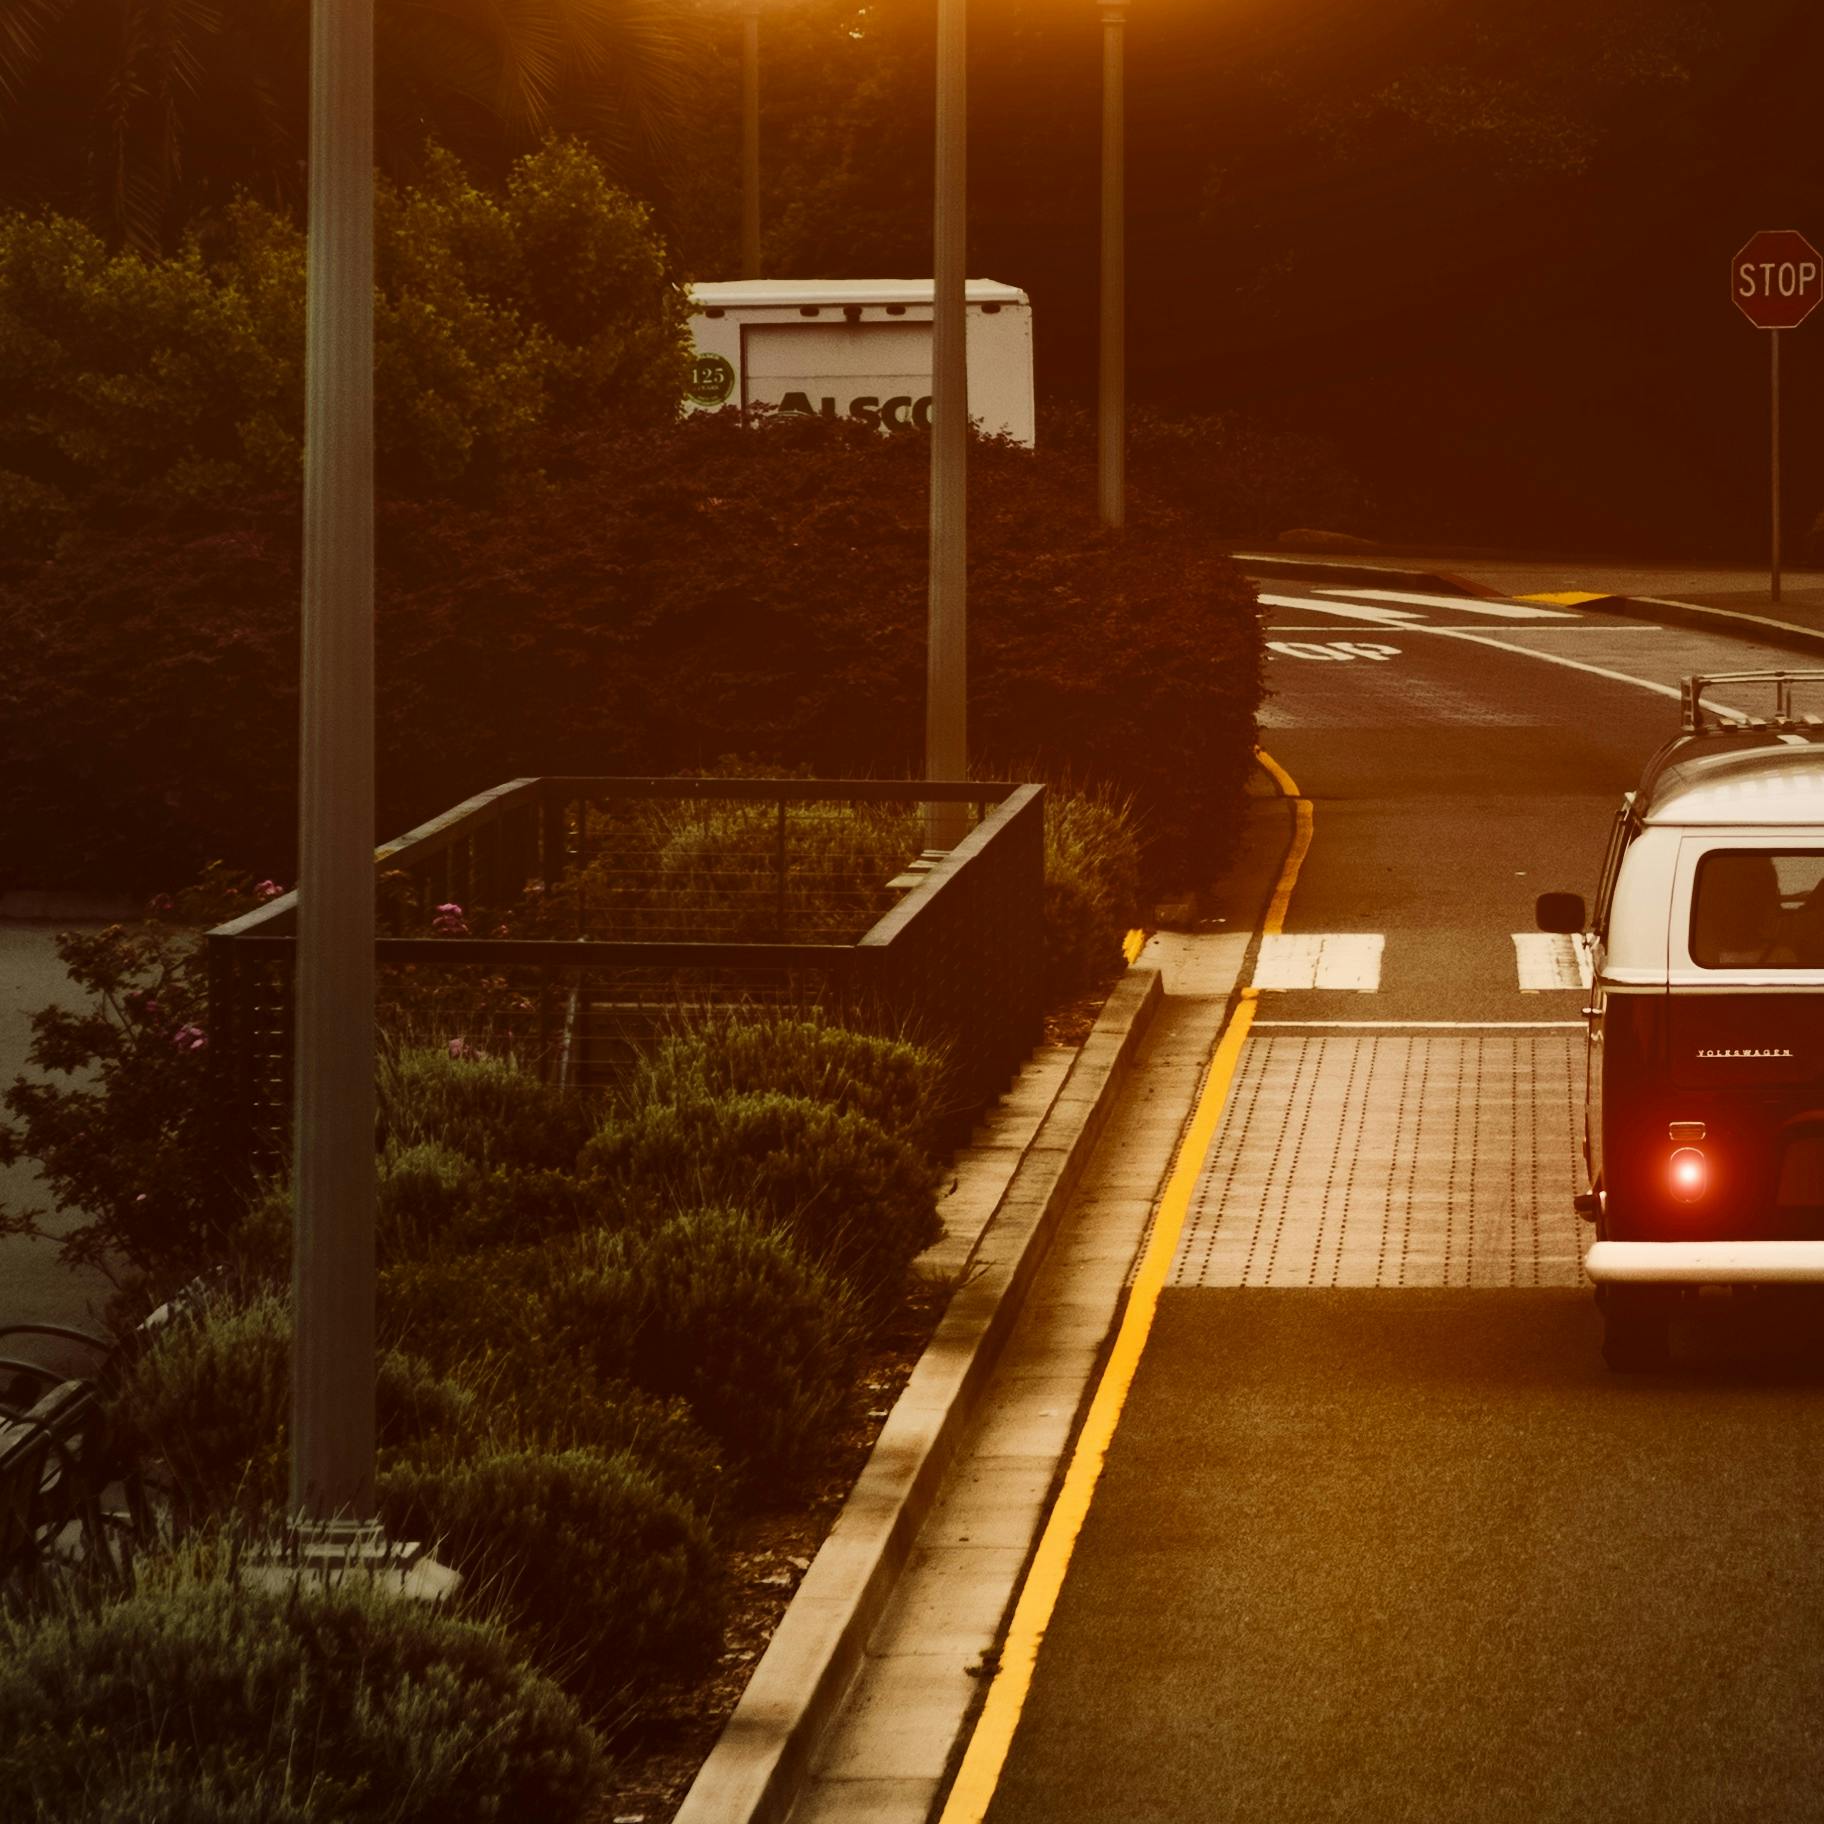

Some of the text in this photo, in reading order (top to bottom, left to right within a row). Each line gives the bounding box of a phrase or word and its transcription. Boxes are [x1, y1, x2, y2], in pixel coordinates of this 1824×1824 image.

[1739, 262, 1816, 297] STOP
[692, 368, 725, 384] 125
[1698, 1049, 1791, 1057] VOLKSWAGEN
